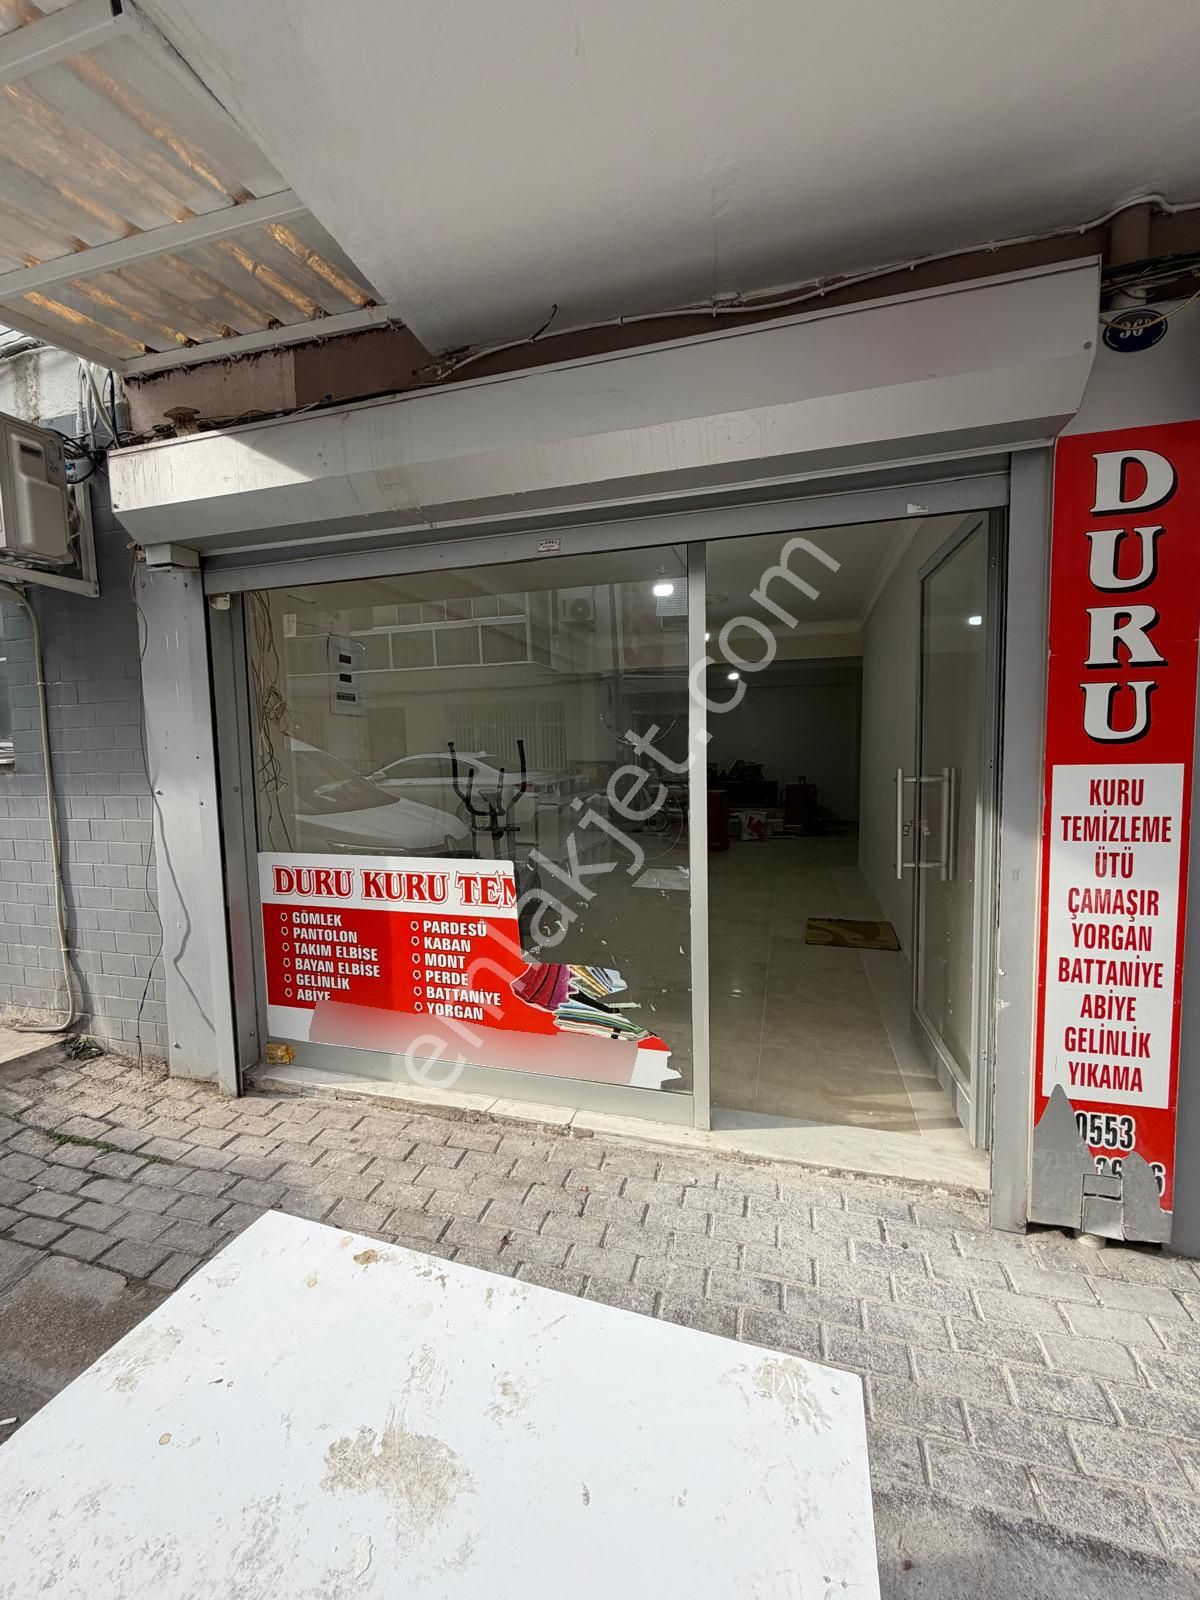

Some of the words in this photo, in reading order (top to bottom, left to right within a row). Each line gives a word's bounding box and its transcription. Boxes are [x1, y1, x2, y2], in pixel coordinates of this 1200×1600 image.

[1080, 449, 1177, 744] DURU
[1089, 779, 1145, 807] KURU
[1061, 810, 1172, 844] TEMİZLEME
[1094, 846, 1134, 879] ÜTÜ
[272, 865, 354, 899] DURU
[361, 869, 450, 904] KURU
[292, 910, 342, 927] GÖMLEK
[1067, 887, 1159, 923] ÇAMAŞIR
[293, 928, 358, 944] PANTOLON
[423, 919, 487, 937] PARDESÜ
[1071, 923, 1153, 953] YORGAN
[294, 942, 332, 958] TAKIM
[336, 945, 378, 962] ELBİSE
[423, 937, 471, 953] KABAN
[295, 958, 334, 974] BAYAN
[338, 961, 381, 978] ELBİSE
[424, 953, 466, 969] MONT
[1058, 954, 1164, 989] BATTANİYE
[296, 973, 350, 990] GELİNLİK
[425, 970, 469, 986] PERDE
[426, 986, 502, 1006] BATTANİYE
[1080, 992, 1137, 1022] ABİYE
[427, 1002, 483, 1020] YORGAN
[1064, 1024, 1151, 1059] GELİNLİK
[1068, 1062, 1143, 1093] YIKAMA
[1075, 1111, 1135, 1150] 0553
